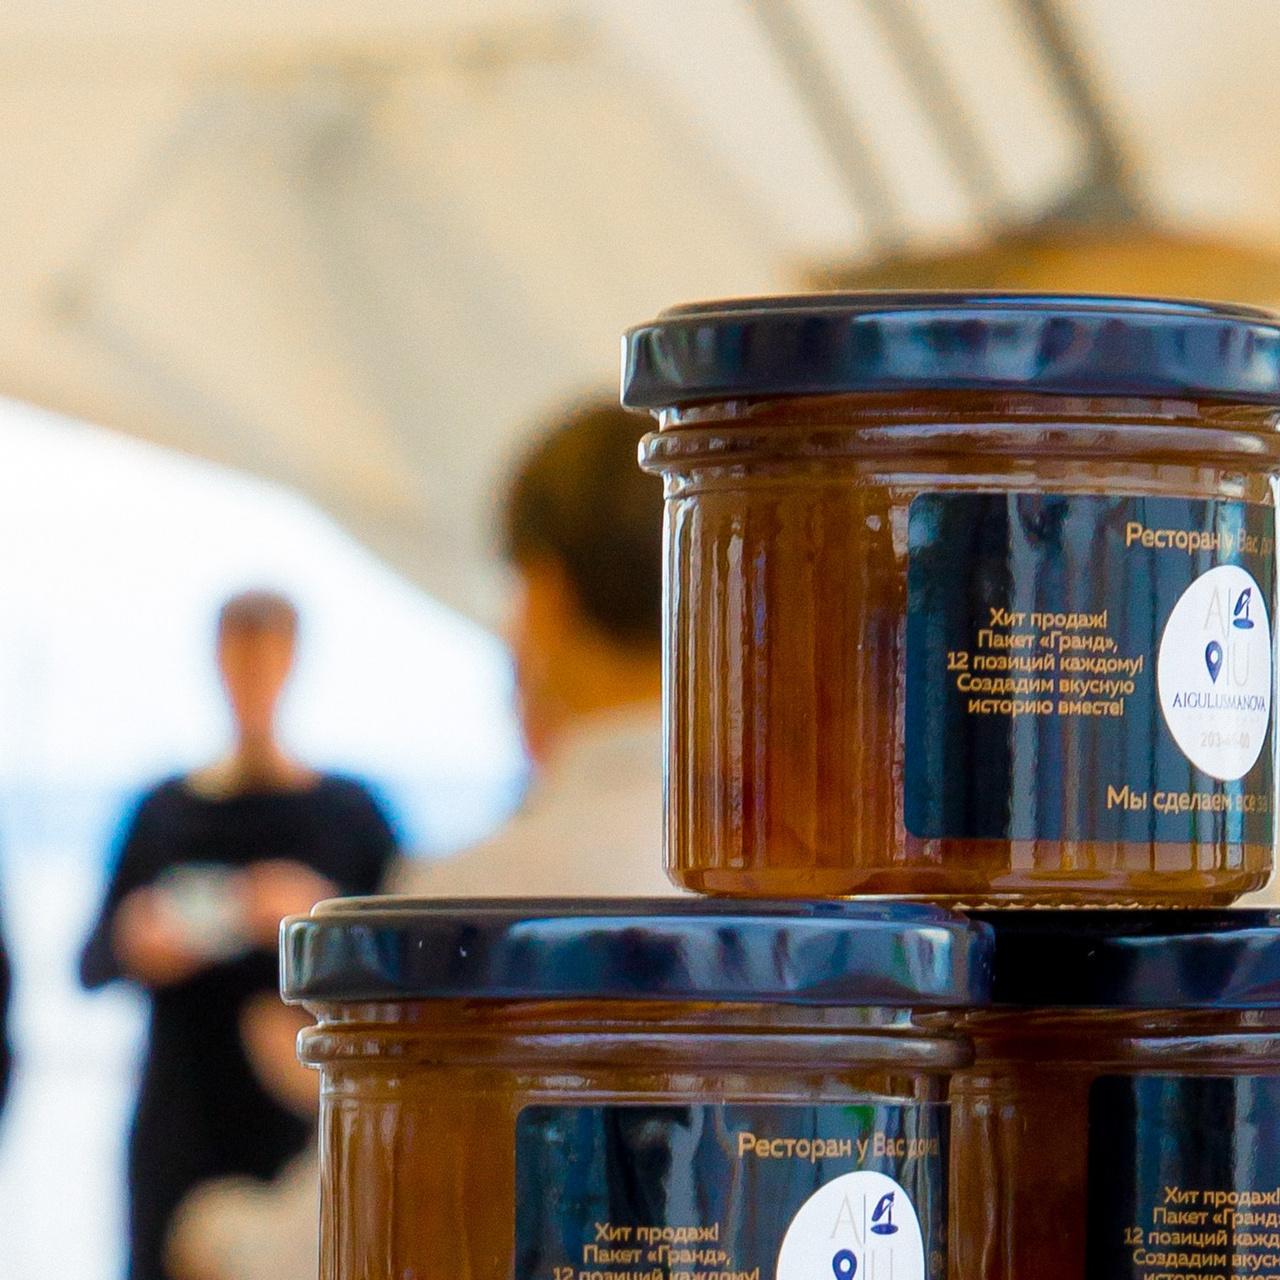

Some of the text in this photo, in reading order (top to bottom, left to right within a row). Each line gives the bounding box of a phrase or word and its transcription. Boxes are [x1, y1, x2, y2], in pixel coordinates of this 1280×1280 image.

[1126, 521, 1220, 556] Ресторан
[990, 608, 1108, 631] Хит продаж!
[978, 631, 1118, 653] Пакет «Гранд»,
[948, 653, 1143, 675] 12 позиций каждому!
[957, 674, 1135, 698] Создадим вкусную
[969, 698, 1124, 719] историю вместе!
[1106, 784, 1232, 814] Мы сделаем
[738, 1132, 852, 1164] Ресторан
[856, 1138, 869, 1164] у
[874, 1132, 905, 1157] Вас
[1165, 1186, 1280, 1208] Хит продаж!
[1153, 1208, 1208, 1225] Пакет
[595, 1223, 719, 1245] Хит продаж!
[1124, 1229, 1143, 1244] 12
[1149, 1231, 1227, 1248] позиций
[584, 1245, 730, 1268] Пакет «Гранд»,
[1133, 1249, 1226, 1268] Создадим
